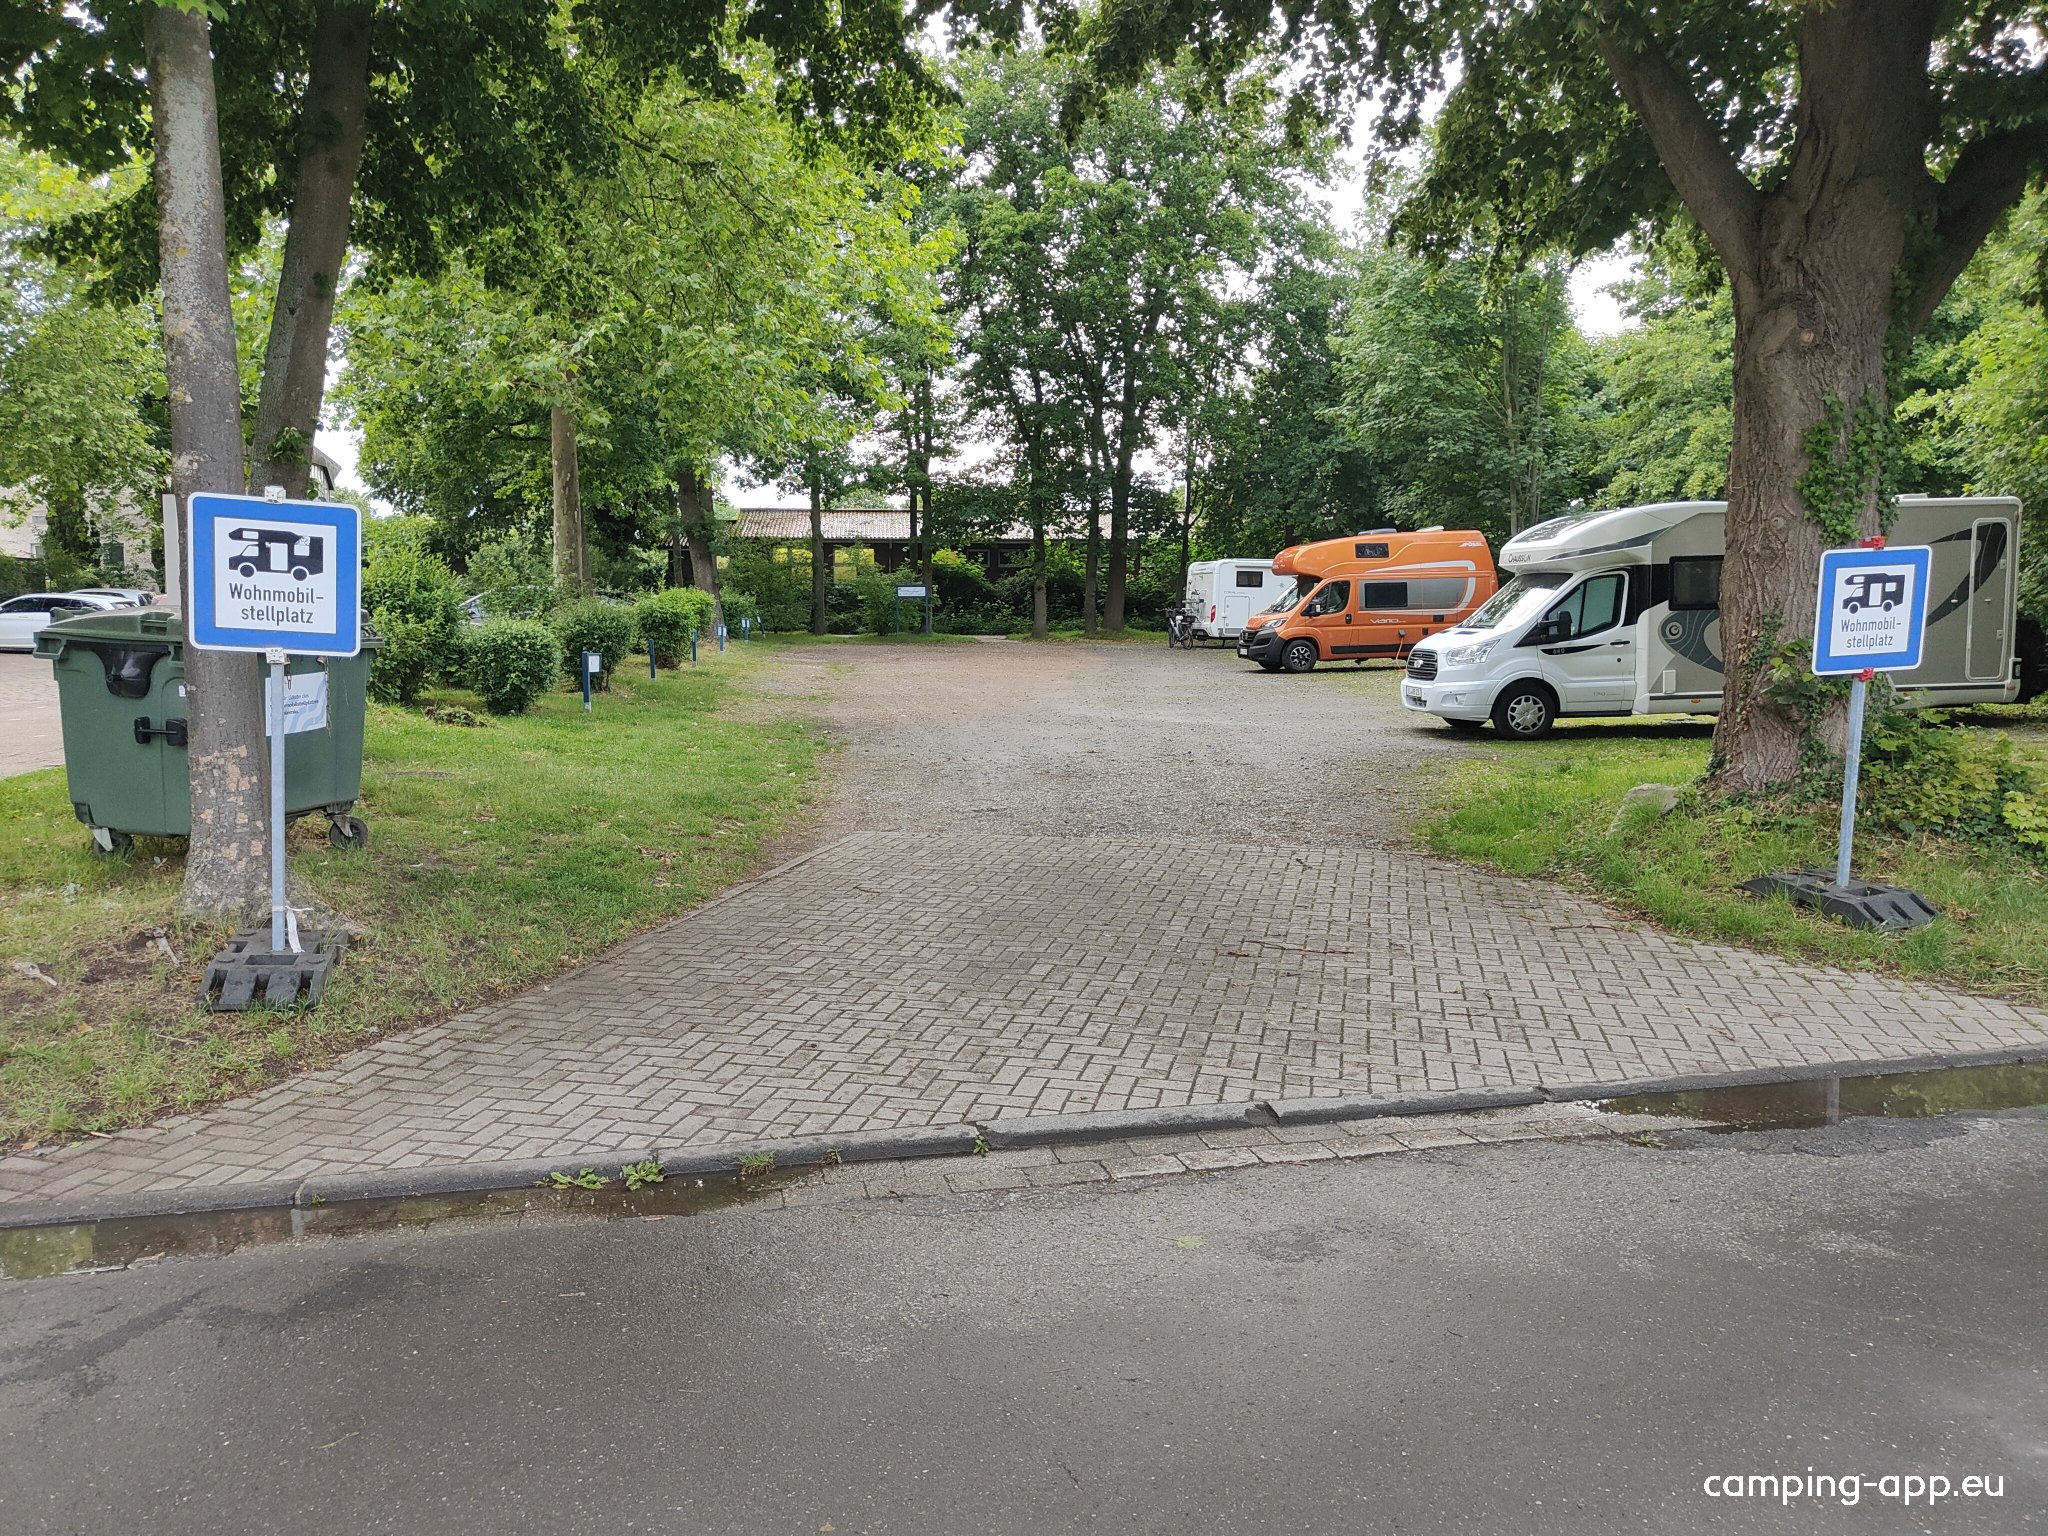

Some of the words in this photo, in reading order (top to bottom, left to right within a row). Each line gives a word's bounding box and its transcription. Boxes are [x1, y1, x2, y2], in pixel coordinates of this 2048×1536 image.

[229, 582, 324, 604] Wohnmobil-
[241, 605, 314, 626] stellplatz
[1841, 616, 1902, 633] Wohnmobil-
[1846, 634, 1894, 651] stellplatz
